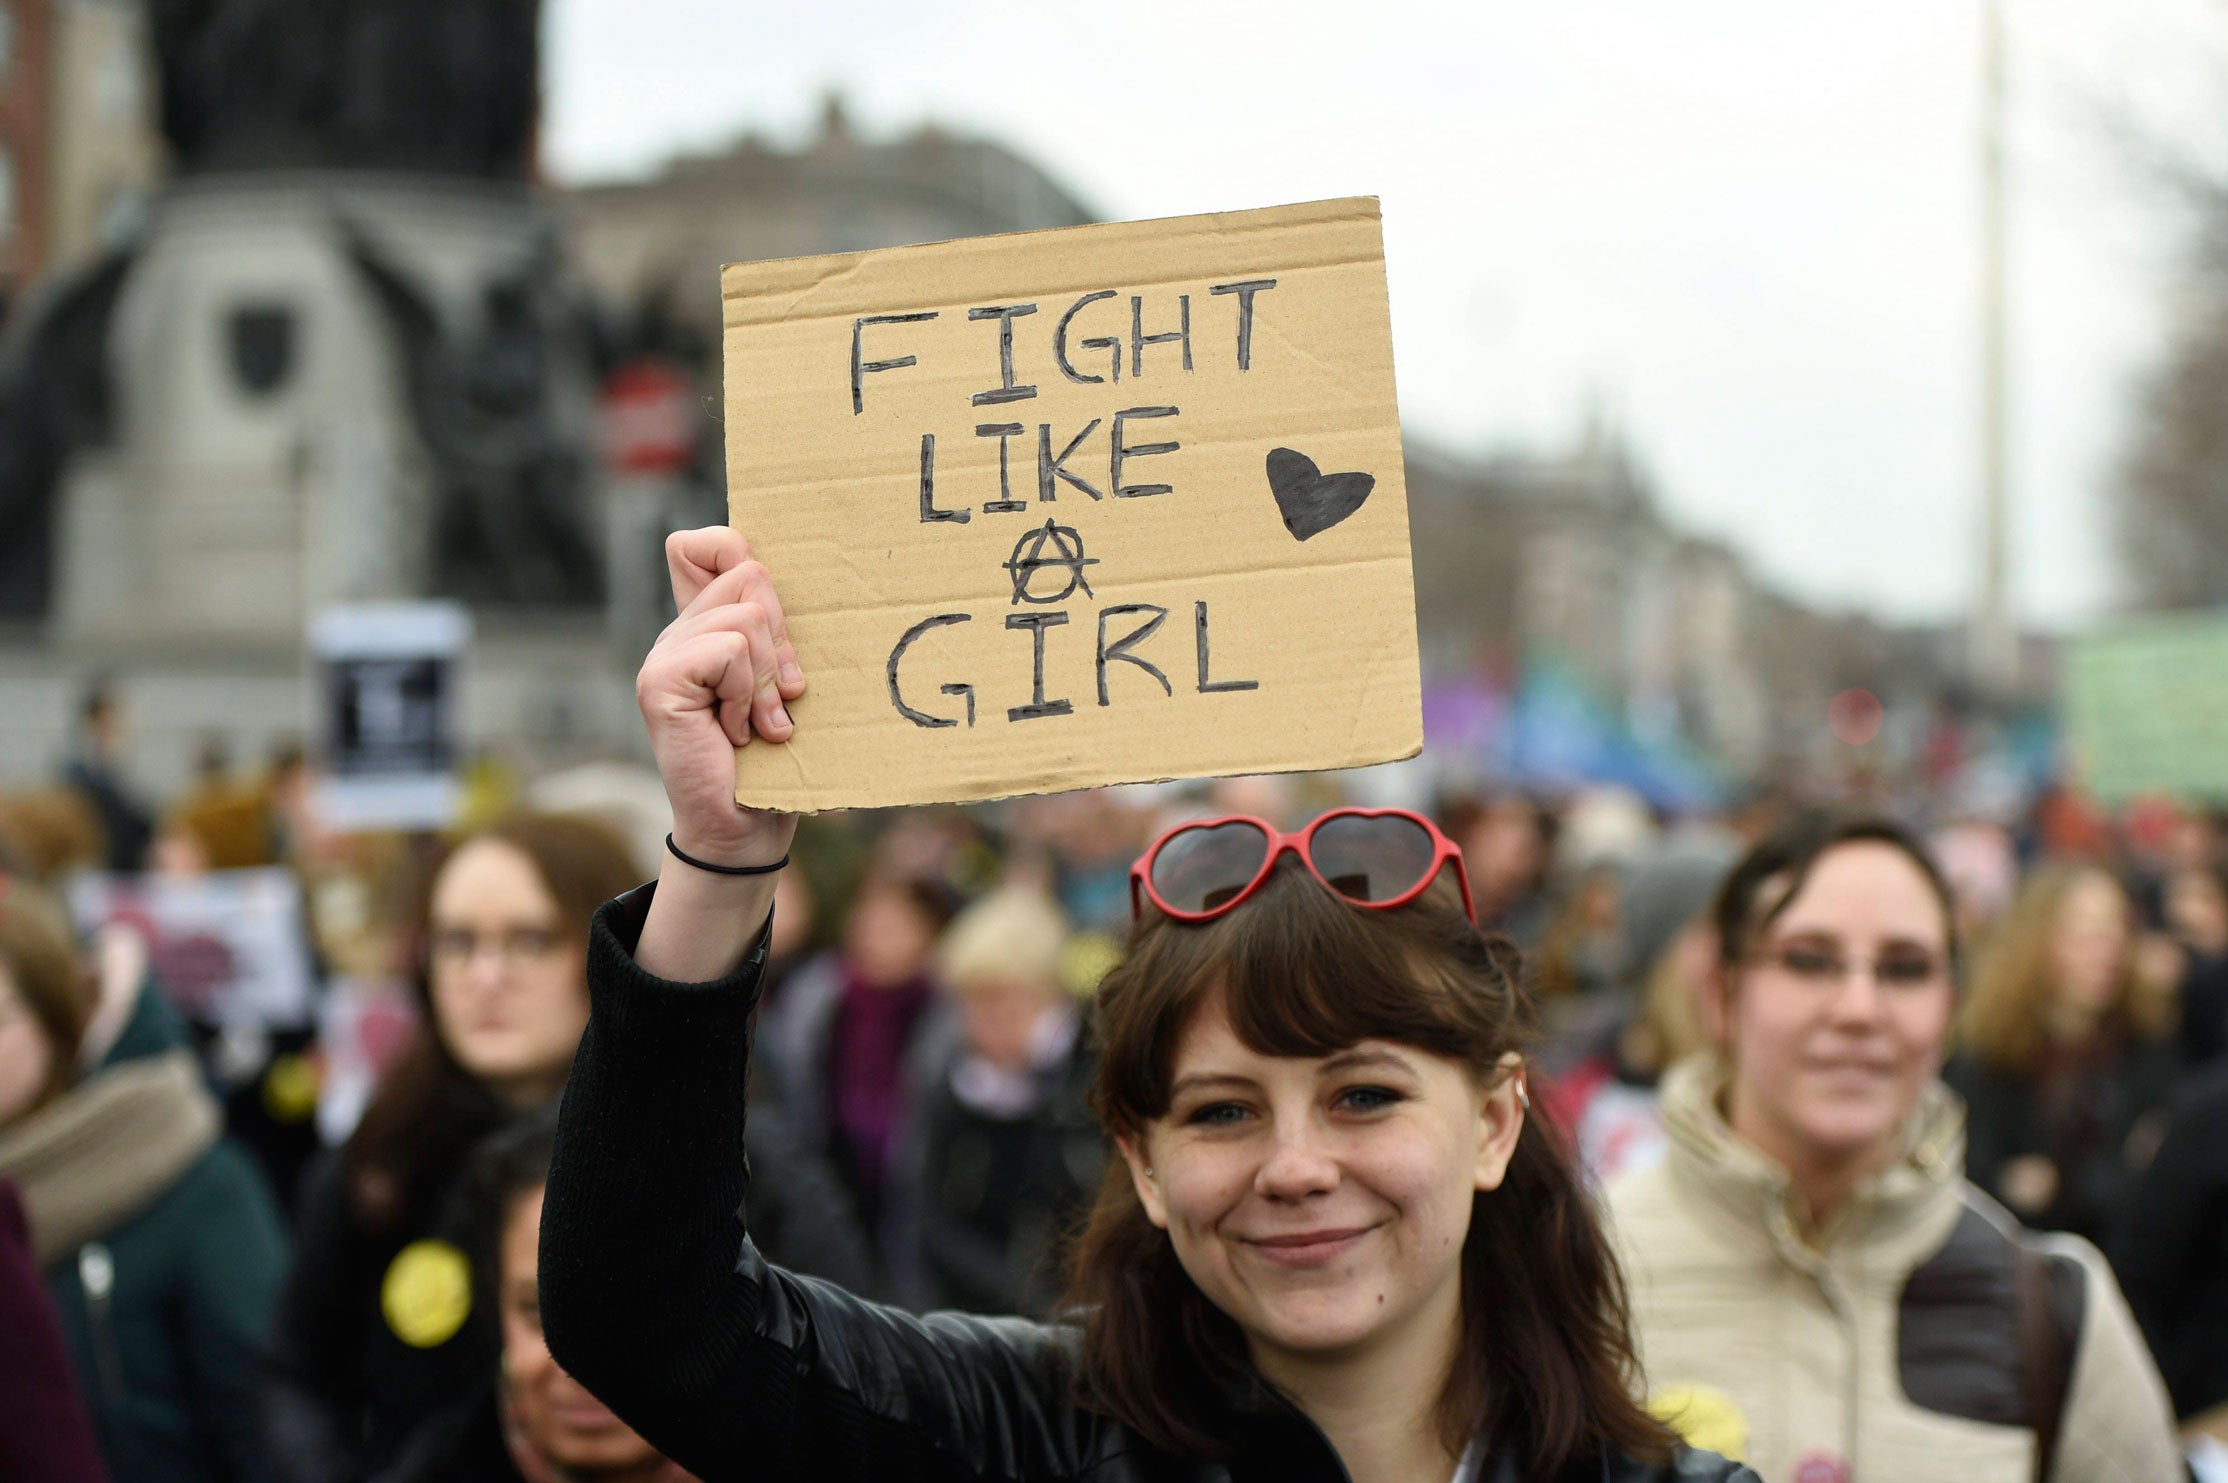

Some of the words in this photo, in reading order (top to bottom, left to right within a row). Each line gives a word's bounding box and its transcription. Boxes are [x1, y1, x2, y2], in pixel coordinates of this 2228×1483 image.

[851, 279, 1277, 416] FIGHT
[920, 406, 1180, 523] LIKE
[1002, 518, 1100, 604] A
[886, 600, 1259, 728] GIRL
